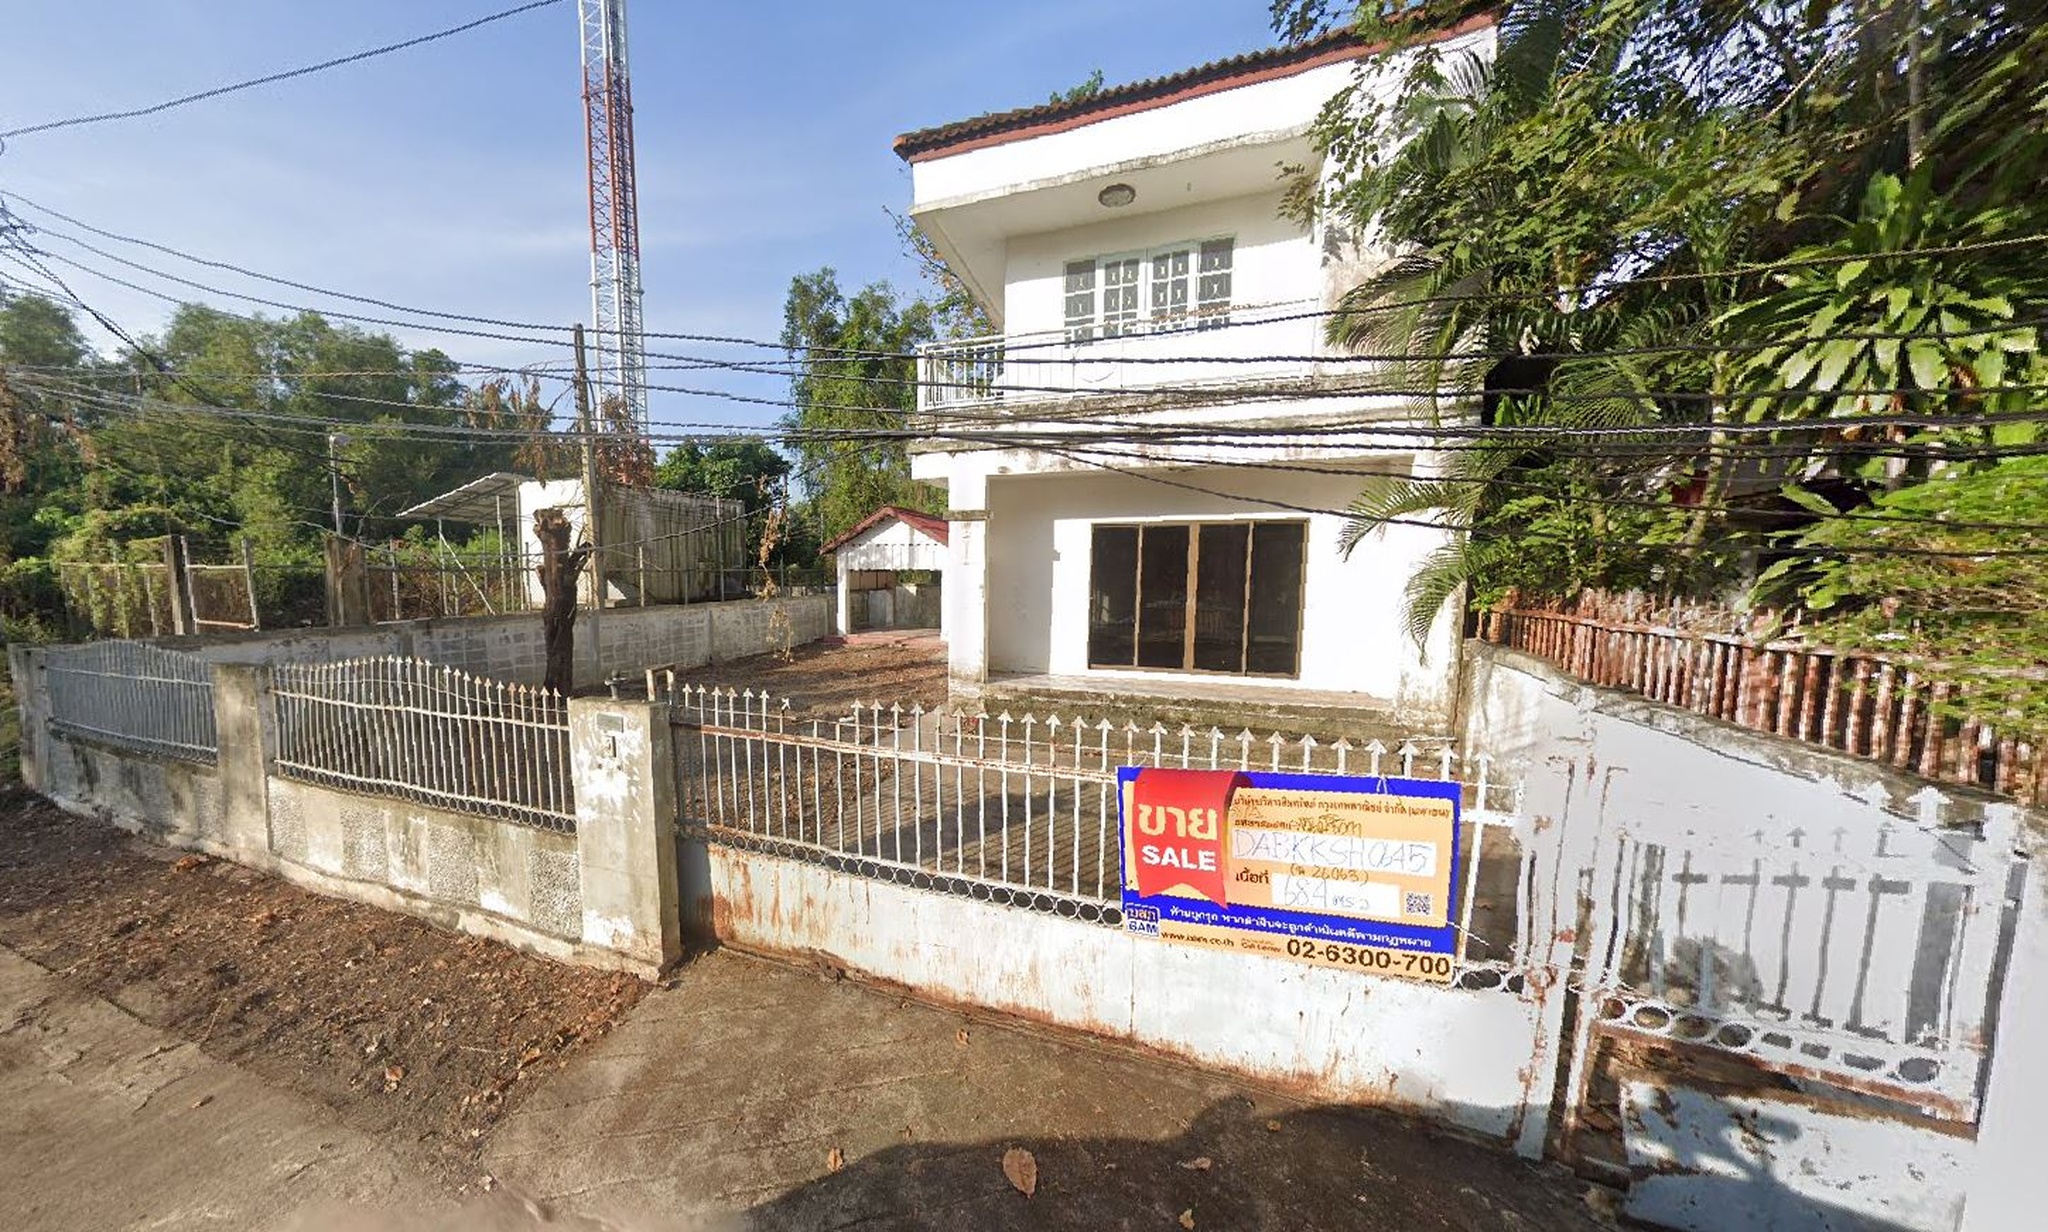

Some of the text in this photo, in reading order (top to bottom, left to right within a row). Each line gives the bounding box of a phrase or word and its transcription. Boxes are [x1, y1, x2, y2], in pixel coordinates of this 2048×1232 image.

[1138, 803, 1218, 840] ขาย
[1141, 844, 1218, 872] SALE
[1235, 867, 1270, 884] เนื้อที่
[1128, 921, 1157, 934] BAM
[1287, 938, 1450, 977] 02-6300-700
